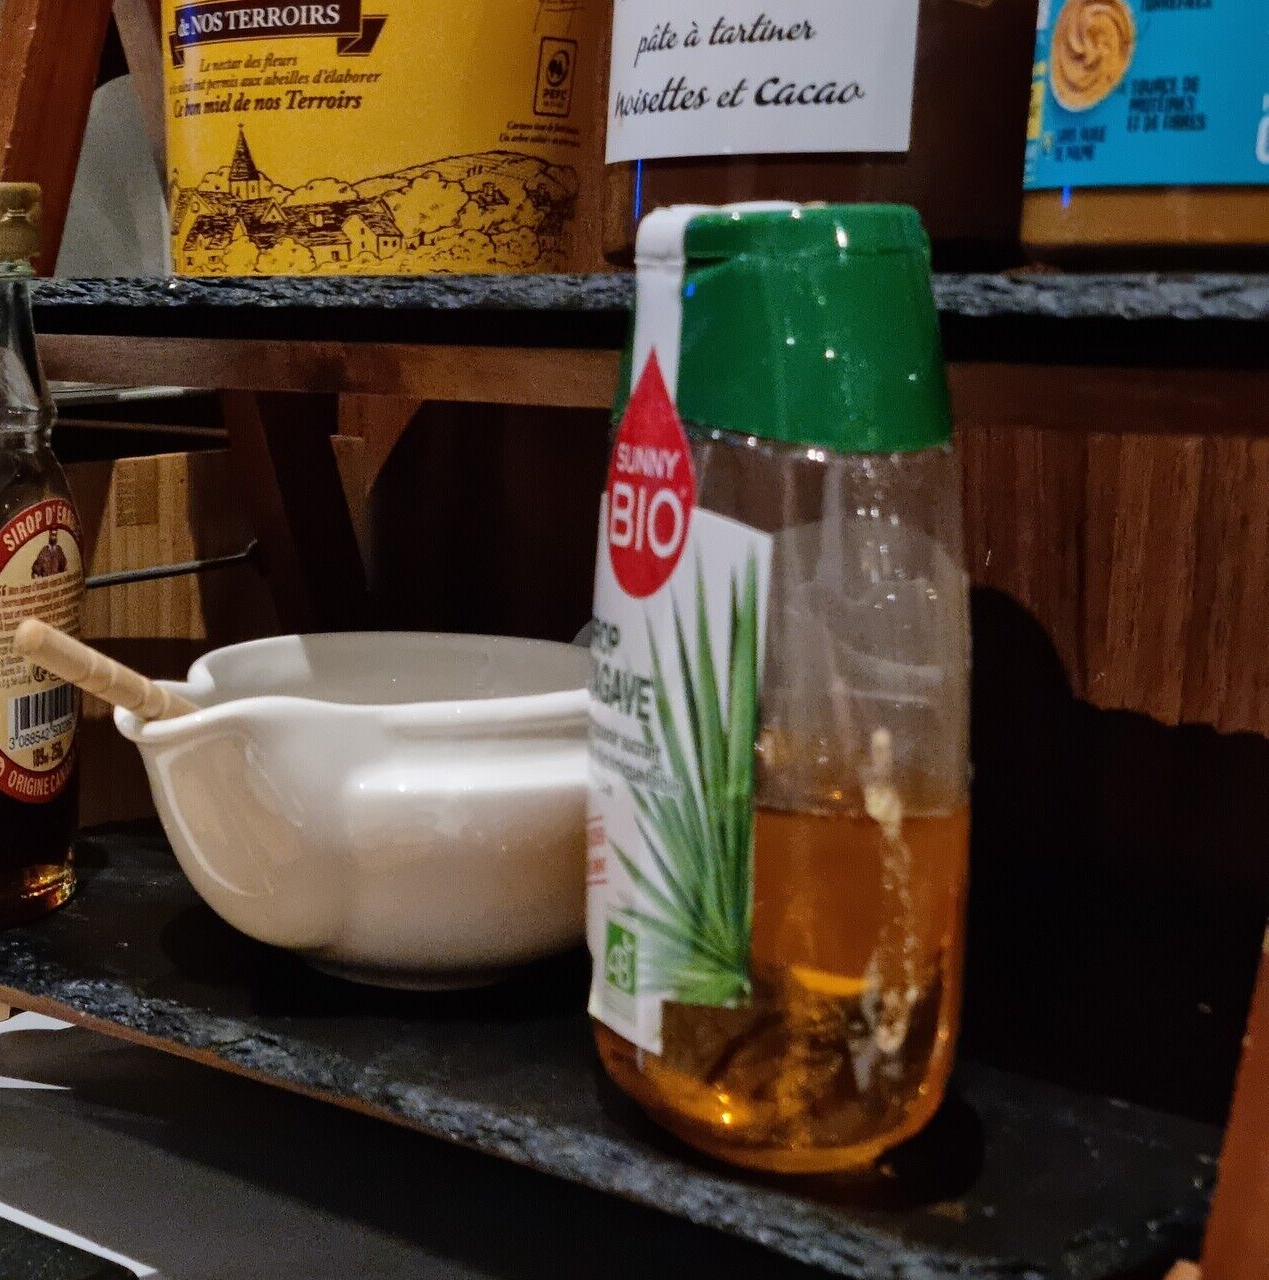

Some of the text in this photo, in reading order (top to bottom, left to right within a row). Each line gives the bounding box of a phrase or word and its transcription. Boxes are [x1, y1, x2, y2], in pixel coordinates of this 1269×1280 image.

[191, 11, 222, 35] NOS
[225, 4, 341, 30] TERROIRS
[634, 13, 817, 68] pâte à tartiner
[261, 53, 297, 73] fleurs
[264, 71, 309, 87] abeilles
[312, 70, 382, 84] d'élaborer
[203, 93, 232, 114] miel
[234, 92, 251, 112] de
[254, 97, 281, 111] nos
[285, 89, 362, 110] Terroirs
[614, 75, 865, 119] noisettes et Cacao
[616, 442, 681, 479] SUNNY
[3, 510, 42, 552] SIROP
[610, 482, 684, 558] BIO
[8, 770, 49, 795] ORIGINE
